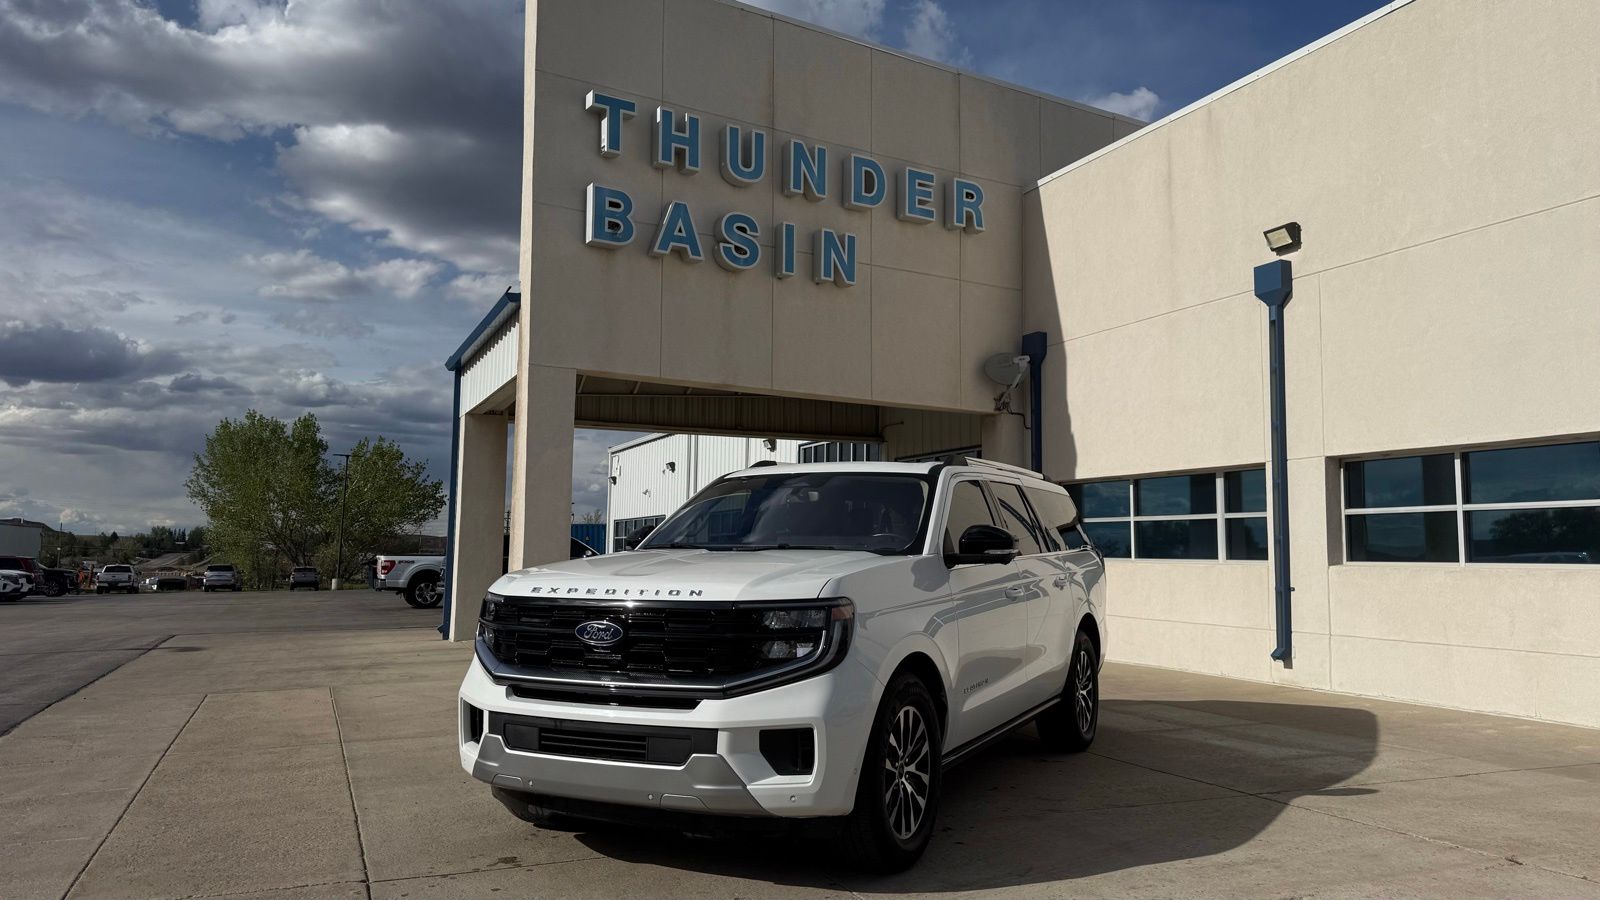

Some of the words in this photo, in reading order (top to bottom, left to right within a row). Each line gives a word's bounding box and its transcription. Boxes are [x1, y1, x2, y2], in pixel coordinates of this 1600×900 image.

[586, 89, 986, 234] THUNDER
[586, 183, 858, 287] BASIN
[530, 586, 703, 597] EXPEDITION
[583, 623, 614, 640] Ford
